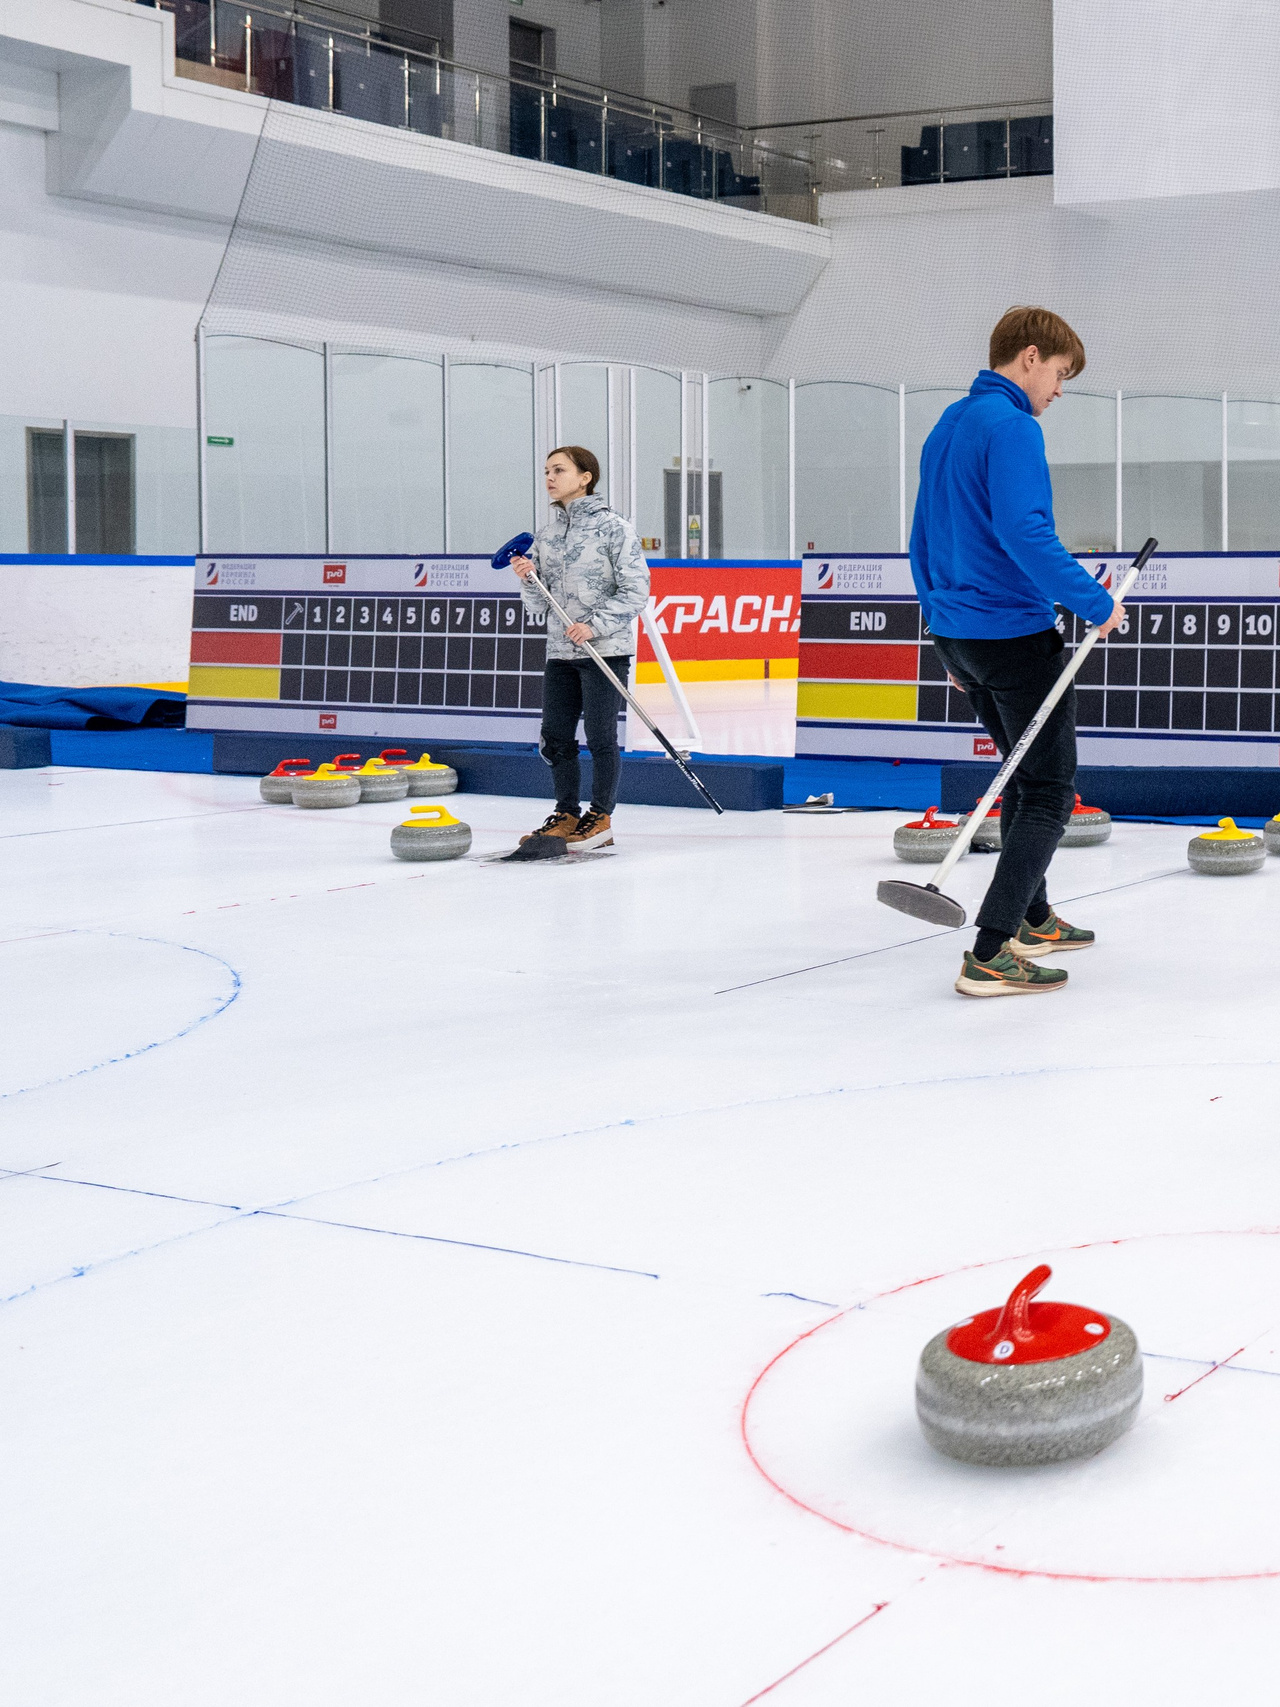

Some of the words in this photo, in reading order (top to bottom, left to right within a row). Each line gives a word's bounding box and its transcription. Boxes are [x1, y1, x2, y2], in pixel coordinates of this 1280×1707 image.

[837, 564, 883, 572] ФЕДЕРАЦИЯ
[230, 604, 258, 621] END
[313, 606, 322, 623] 1
[335, 606, 346, 623] 2
[360, 606, 369, 624] 3
[382, 607, 392, 624] 4
[406, 607, 416, 624] 5
[430, 607, 441, 625] 6
[455, 607, 465, 625] 7
[480, 608, 491, 626] 8
[505, 608, 516, 626] 9
[526, 610, 546, 626] 10
[850, 611, 887, 631] END
[1150, 614, 1163, 635] 7
[1183, 614, 1197, 635] 8
[1217, 615, 1231, 635] 9
[1245, 615, 1272, 636] 10
